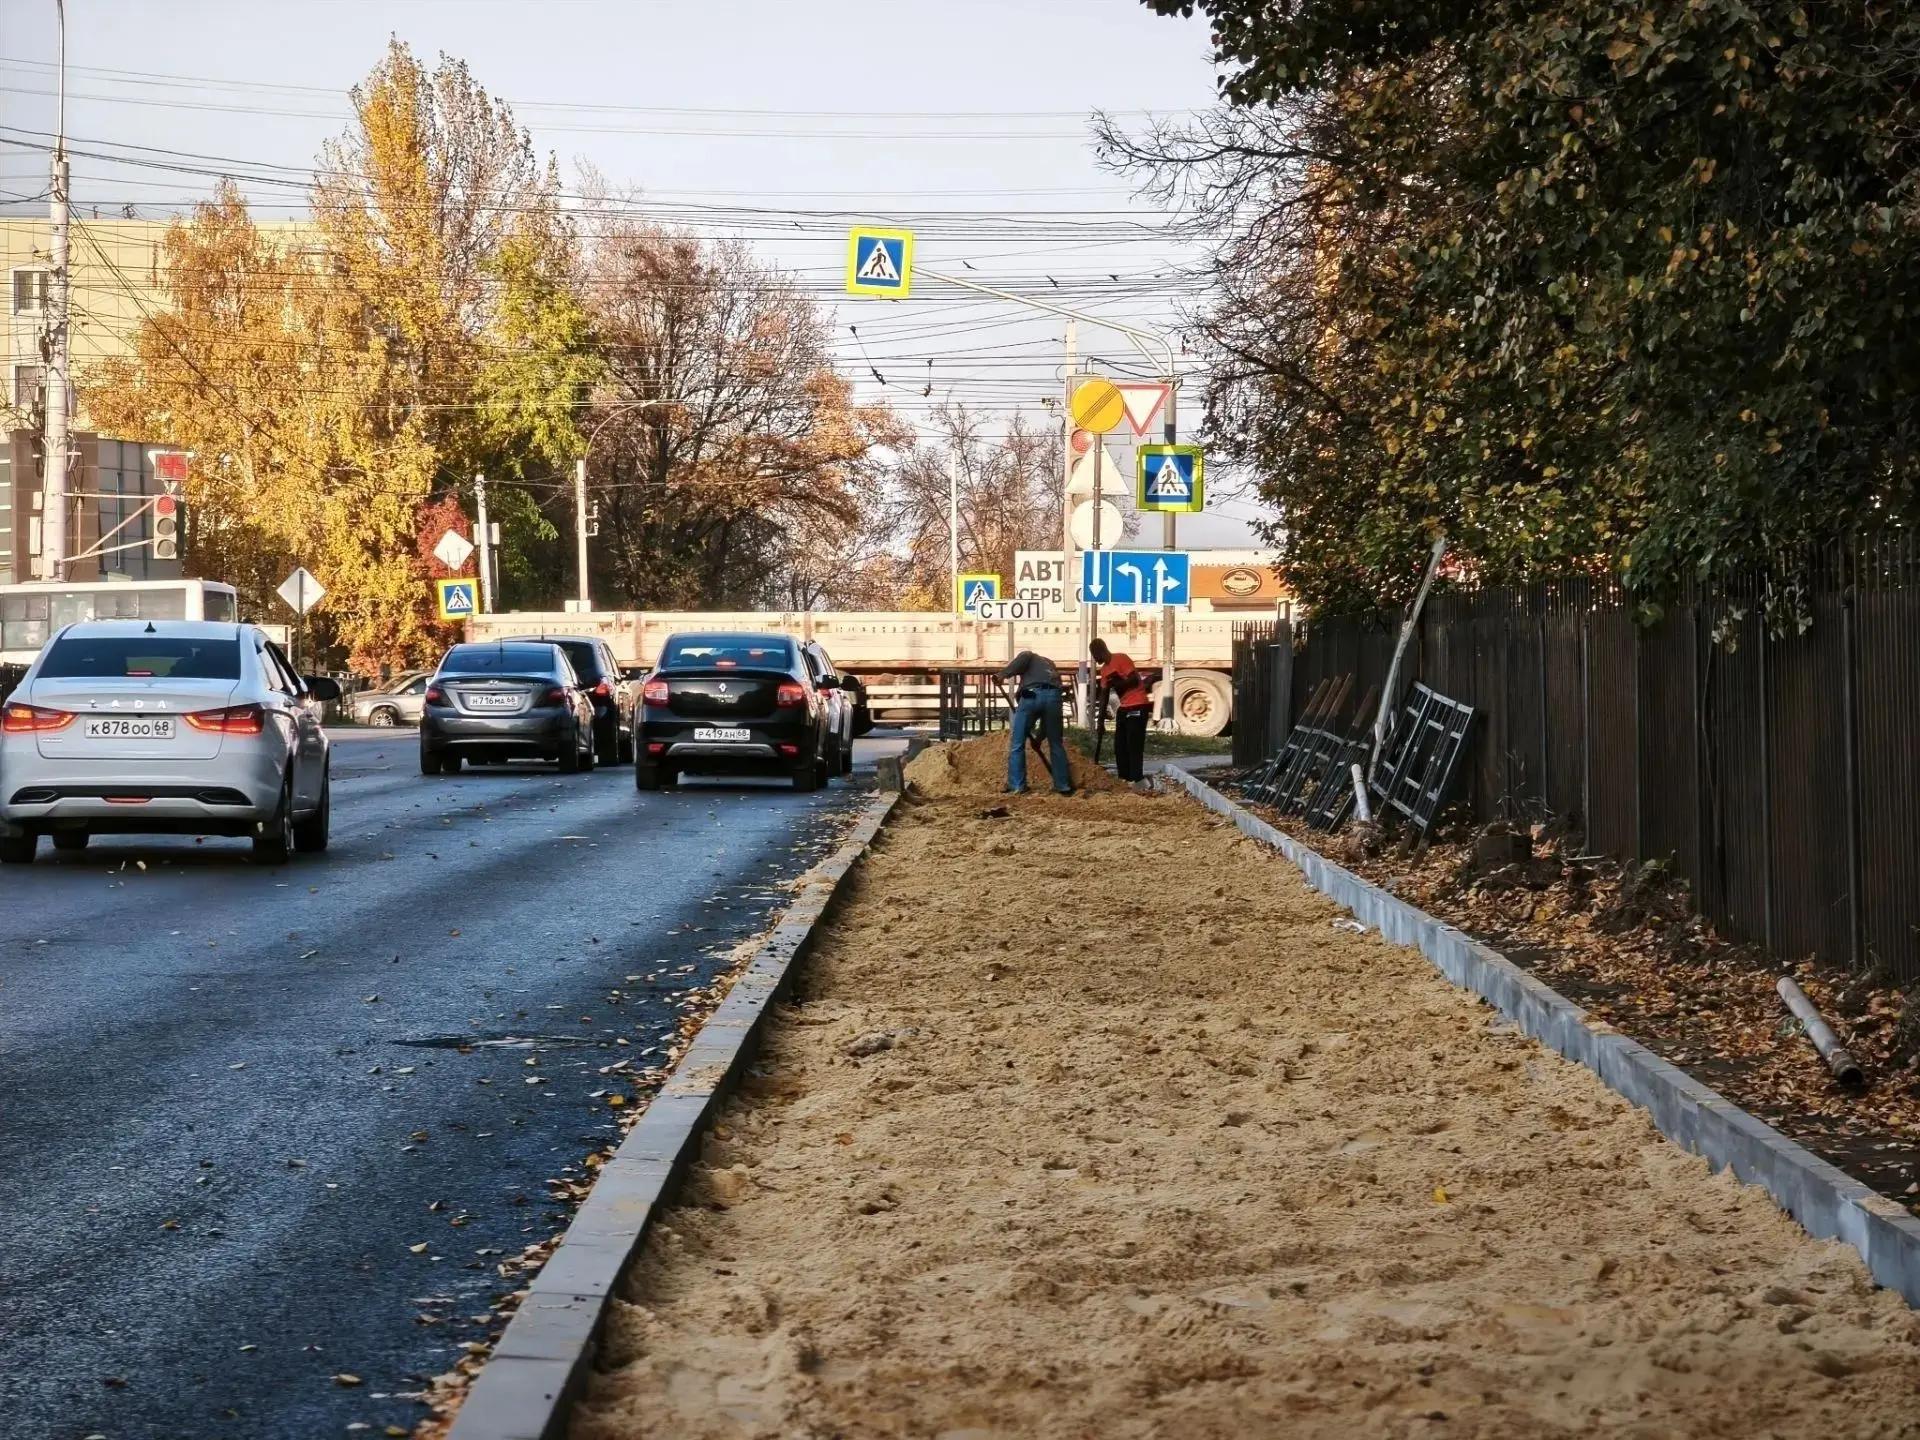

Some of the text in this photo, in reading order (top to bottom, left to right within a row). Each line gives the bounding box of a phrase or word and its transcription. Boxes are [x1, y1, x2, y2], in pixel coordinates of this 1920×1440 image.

[1019, 560, 1064, 581] АВТ
[980, 602, 1040, 618] СТОП
[90, 699, 167, 709] LADA
[91, 721, 169, 735] К878ОО 68
